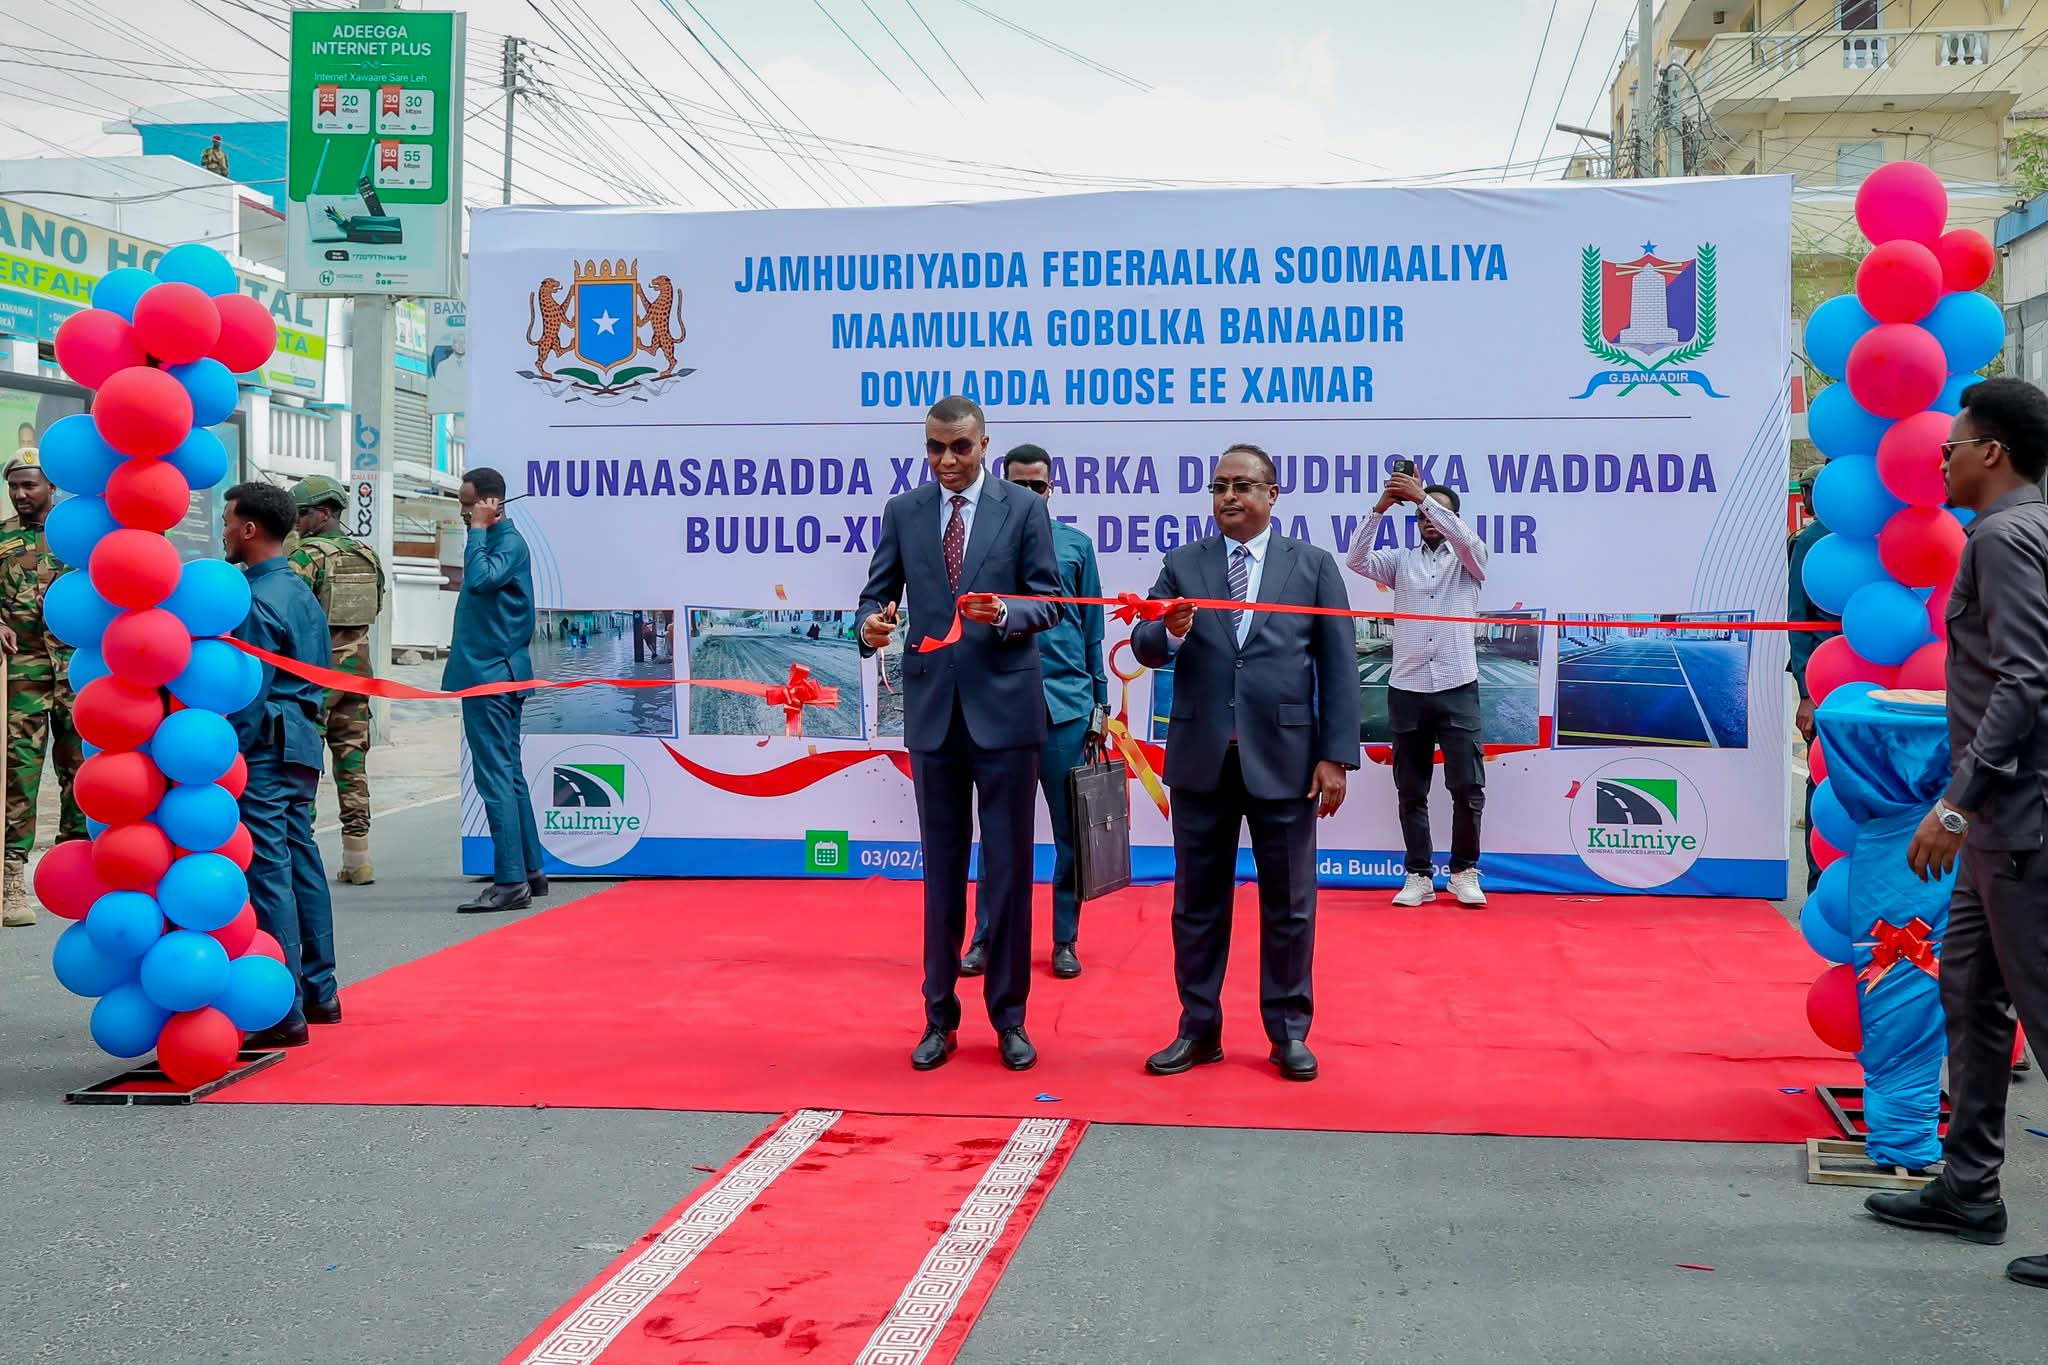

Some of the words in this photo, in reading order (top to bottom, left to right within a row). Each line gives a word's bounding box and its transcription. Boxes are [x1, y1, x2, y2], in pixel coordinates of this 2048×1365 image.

[333, 25, 408, 39] ADEEGGA
[312, 42, 387, 56] INTERNET
[391, 43, 432, 56] PLUS
[314, 73, 348, 82] Internet
[351, 74, 387, 82] Xawaare
[389, 74, 408, 82] Sare
[411, 74, 427, 83] Leh
[342, 95, 359, 106] 20
[405, 96, 422, 108] 30
[404, 151, 421, 162] 55
[735, 252, 1029, 293] JAMHUURIYADDA
[1043, 248, 1261, 288] FEDERAALKA
[1274, 243, 1508, 284] SOOMAALIYA
[831, 310, 1033, 349] MAAMULKA
[1047, 307, 1205, 347] GOBOLKA
[1220, 305, 1404, 344] BANAADIR
[277, 331, 308, 353] TA
[861, 369, 1051, 407] DOWLADDA
[1065, 367, 1175, 406] HOOSE
[1190, 367, 1227, 404] EE
[1240, 366, 1374, 404] XAMAR
[1608, 372, 1689, 383] G.BANAADIR
[527, 458, 873, 497] MUNAASABADDA
[1487, 453, 1717, 493] WADDADA
[353, 482, 372, 535] beco
[544, 811, 640, 835] Kulmiye
[1588, 828, 1697, 855] Kulmiye
[1315, 857, 1343, 875] da
